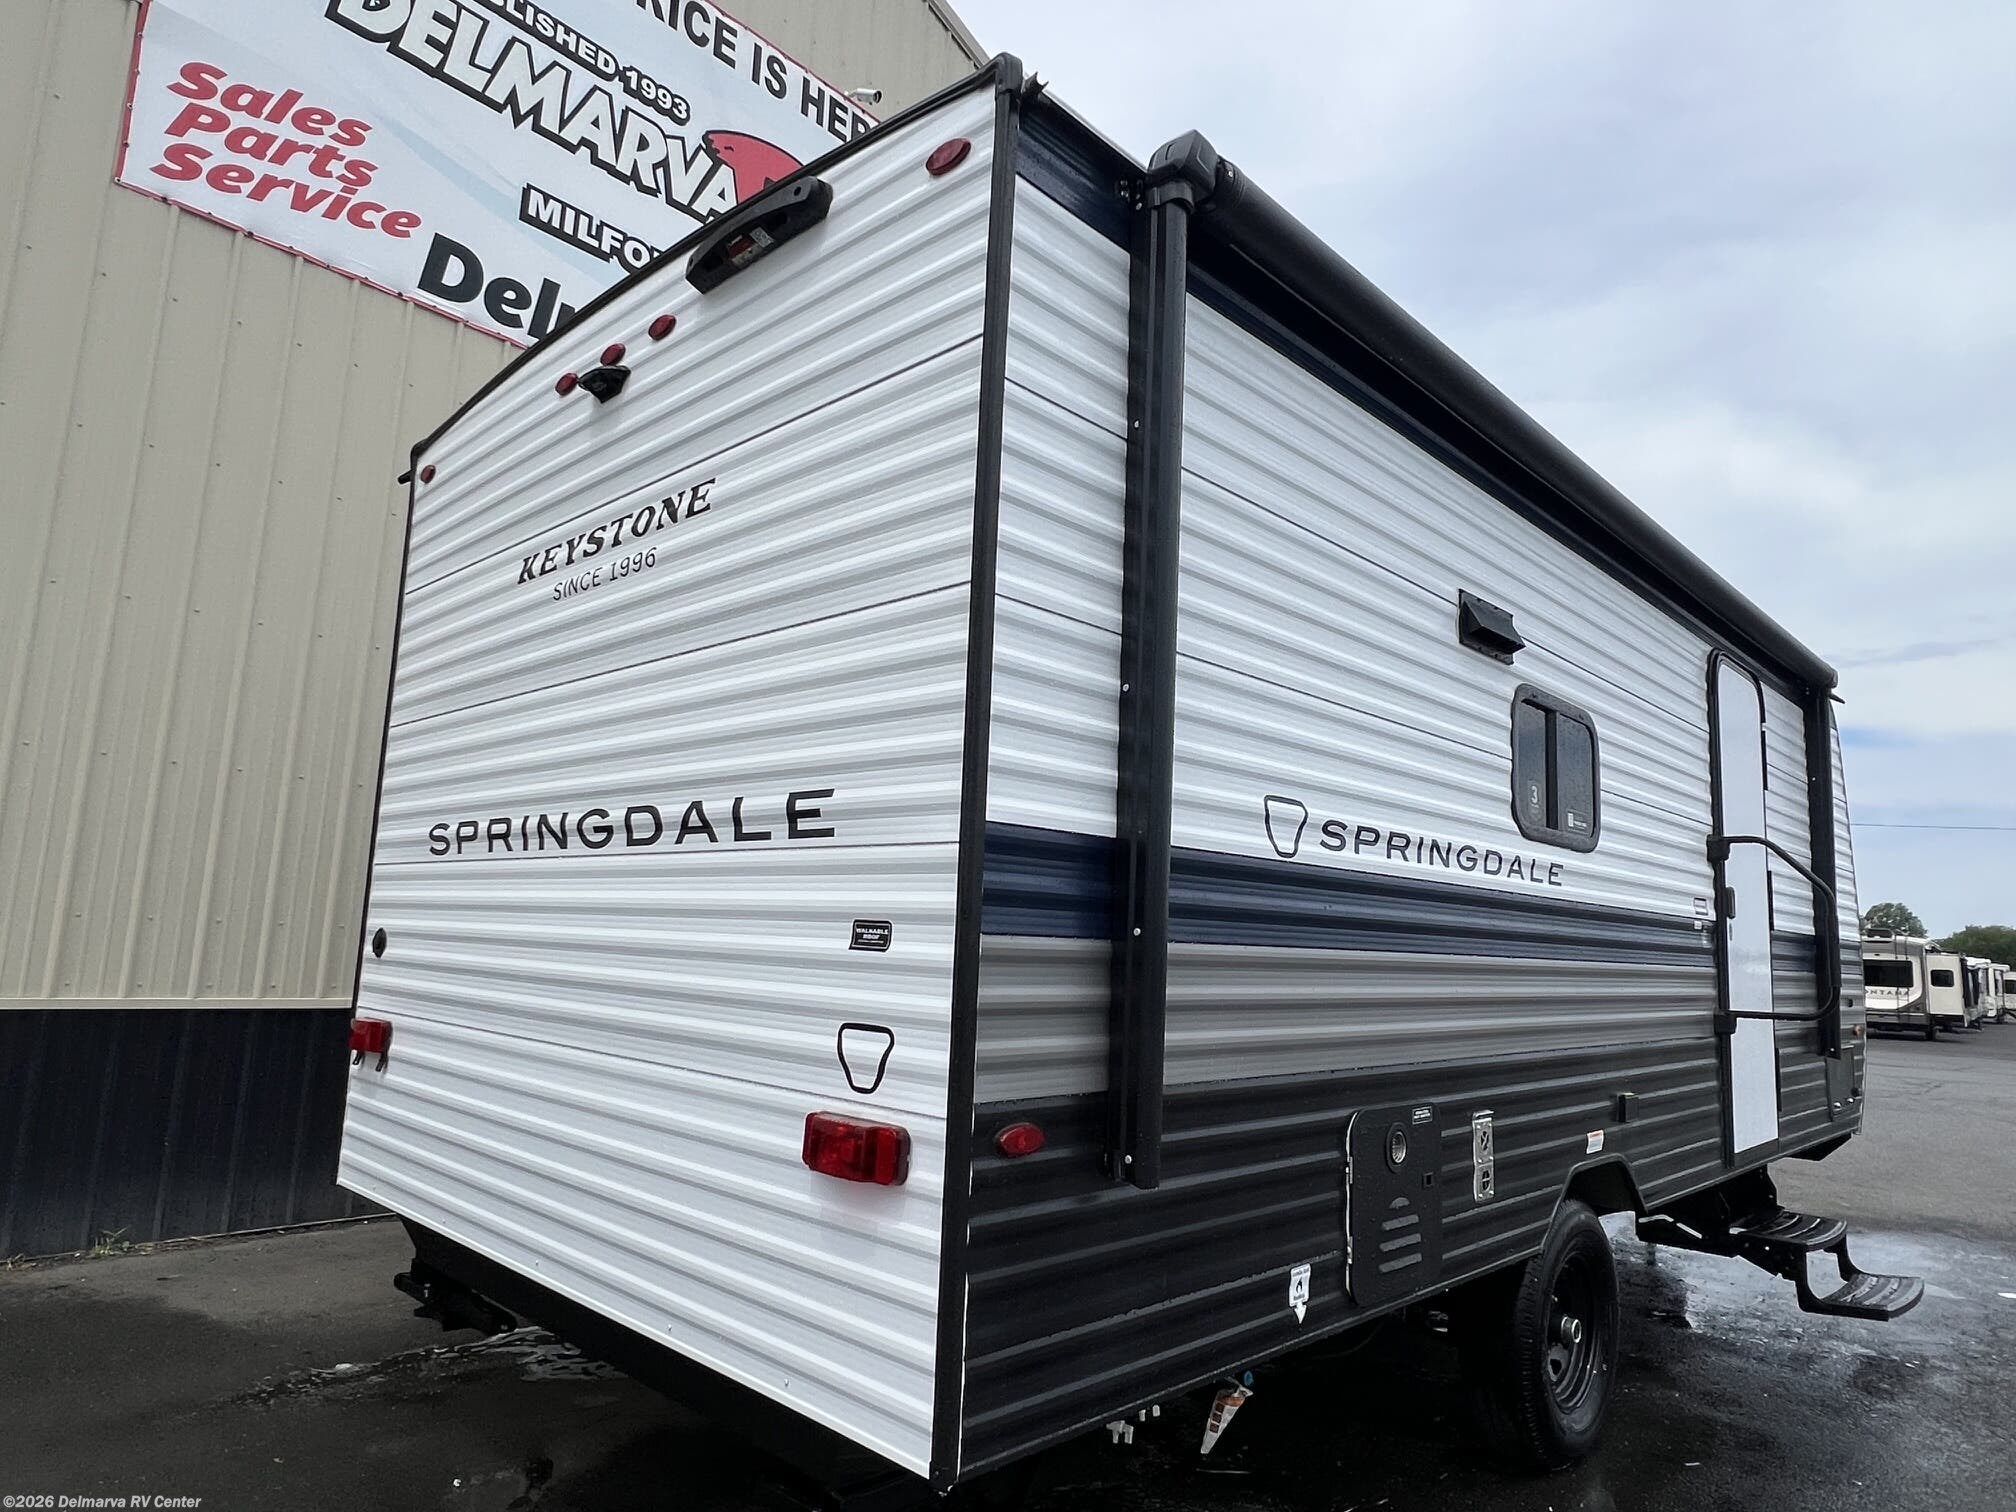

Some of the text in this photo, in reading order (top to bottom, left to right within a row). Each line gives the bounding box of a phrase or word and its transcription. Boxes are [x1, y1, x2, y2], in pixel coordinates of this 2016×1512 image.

[489, 0, 689, 123] LISHED 1993
[636, 0, 737, 69] ICE
[752, 43, 788, 99] IS
[164, 103, 378, 187] Parts
[165, 62, 372, 147] Sales
[149, 142, 422, 238] Service
[521, 183, 662, 272] MILFO
[517, 478, 716, 584] KEYSTONE
[553, 546, 657, 601] SINCE 1996
[429, 788, 836, 856] SPRINGDALE
[1319, 819, 1564, 887] SPRINGDALE
